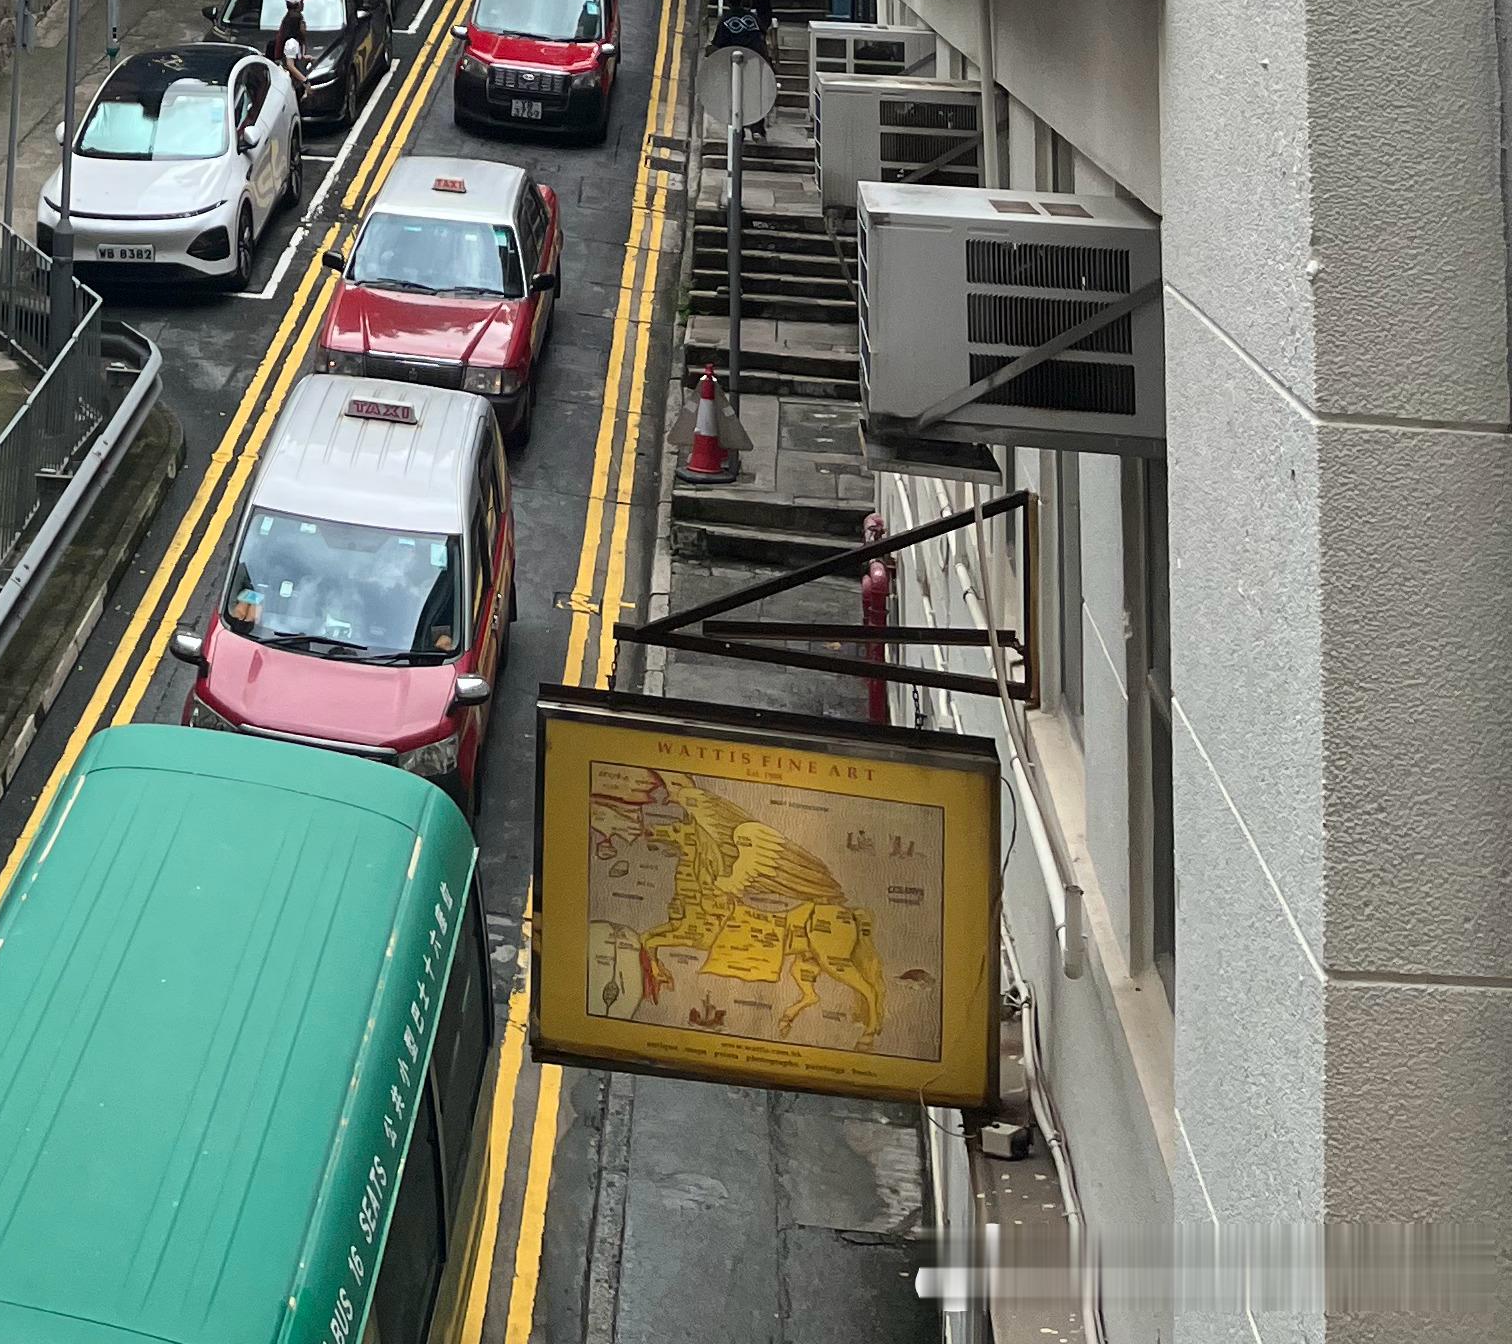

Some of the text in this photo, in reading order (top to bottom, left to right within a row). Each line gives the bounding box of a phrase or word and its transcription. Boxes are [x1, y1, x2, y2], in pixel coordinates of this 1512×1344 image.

[435, 178, 463, 190] TAXI
[353, 399, 410, 419] TAXI
[658, 741, 876, 781] WATTIS FINE ART
[348, 1246, 364, 1286] 16
[359, 1155, 387, 1244] SEATS
